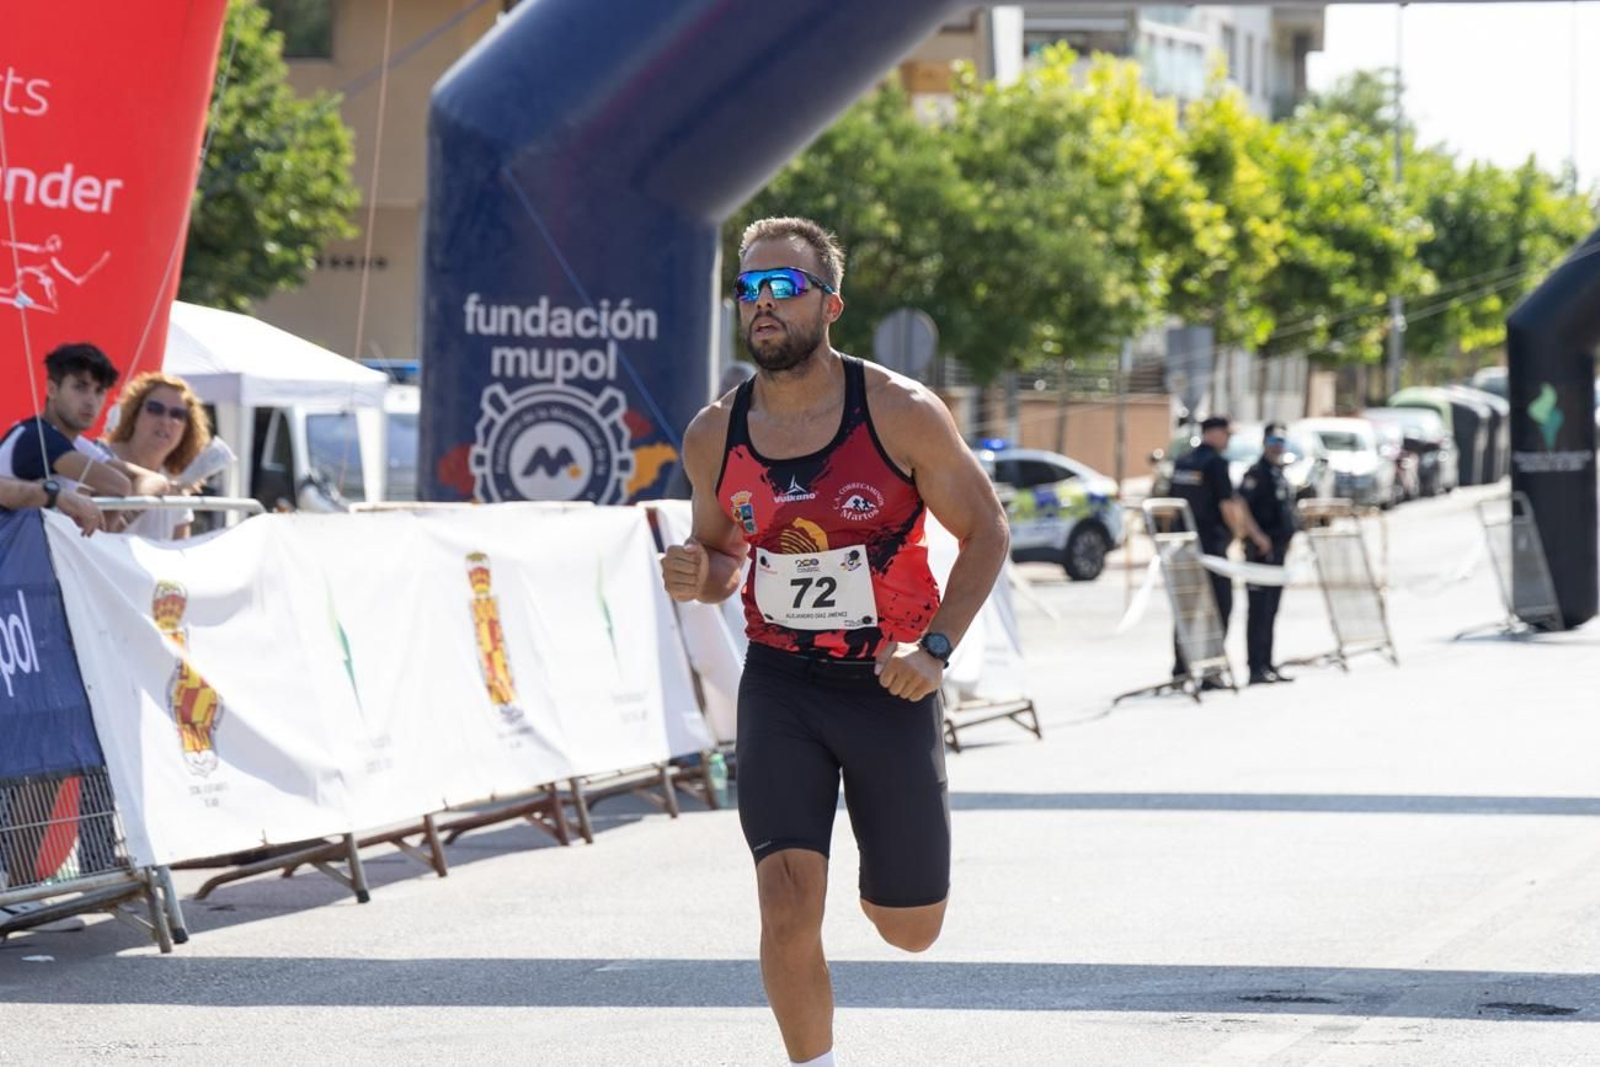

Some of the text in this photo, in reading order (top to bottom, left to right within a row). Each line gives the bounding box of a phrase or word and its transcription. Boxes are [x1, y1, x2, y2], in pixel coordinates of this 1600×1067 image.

[0, 66, 51, 116] ts
[0, 162, 124, 213] nder
[464, 293, 657, 340] fundación
[491, 340, 617, 387] mupol
[773, 492, 816, 503] Vulkano
[840, 508, 879, 521] Martos
[790, 576, 837, 608] 72
